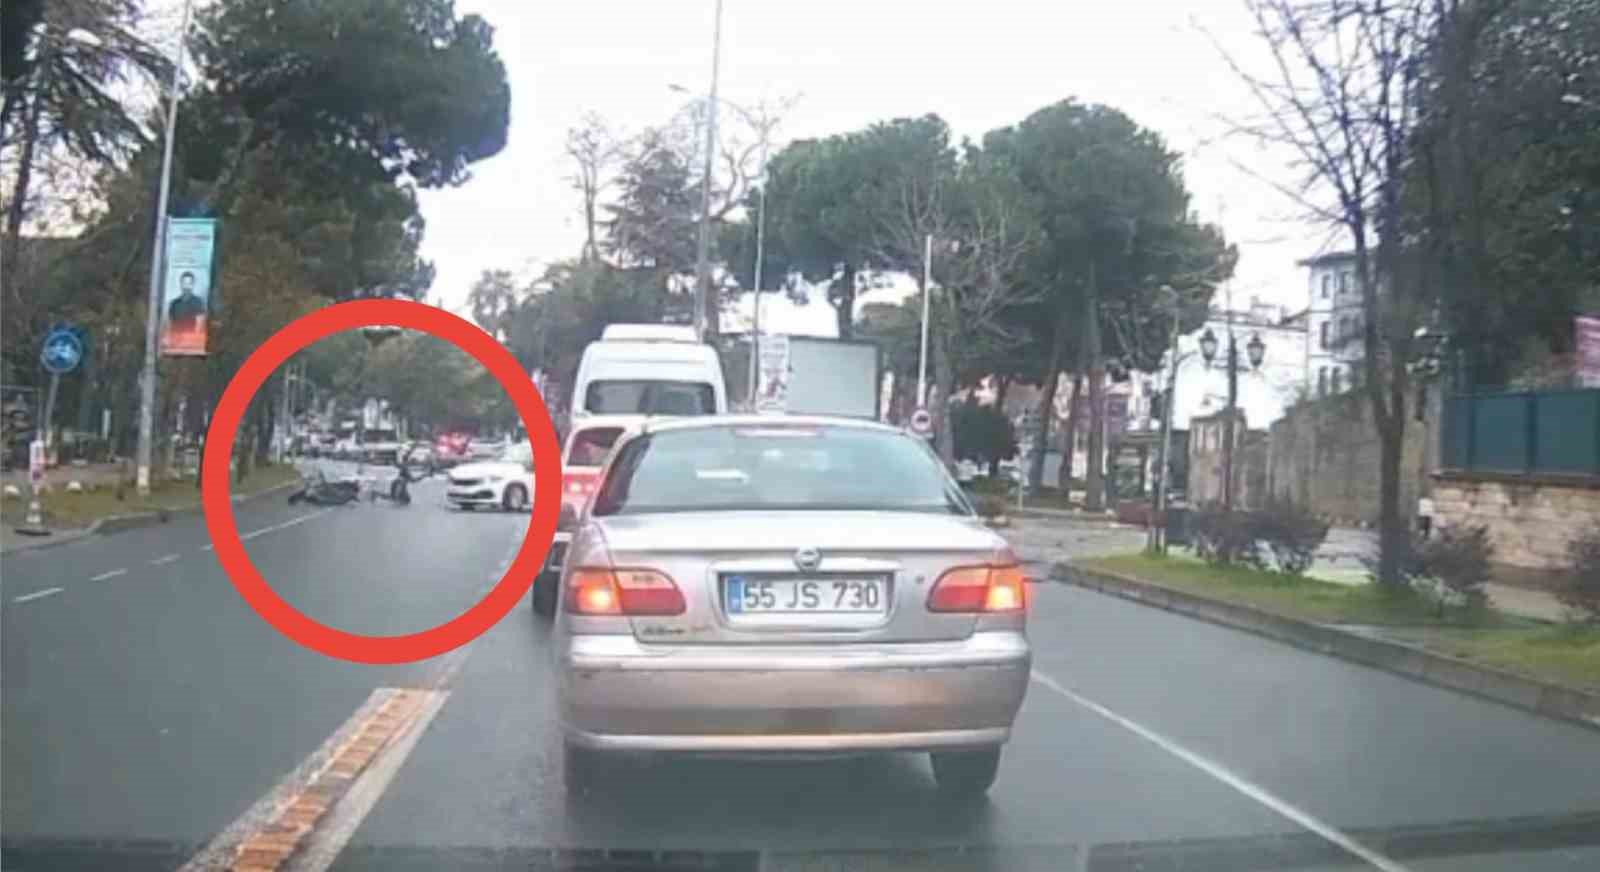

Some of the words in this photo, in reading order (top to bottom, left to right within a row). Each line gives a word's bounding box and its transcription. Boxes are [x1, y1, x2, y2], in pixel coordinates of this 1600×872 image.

[743, 582, 775, 609] 55
[785, 582, 820, 609] JS
[833, 582, 879, 609] 730
